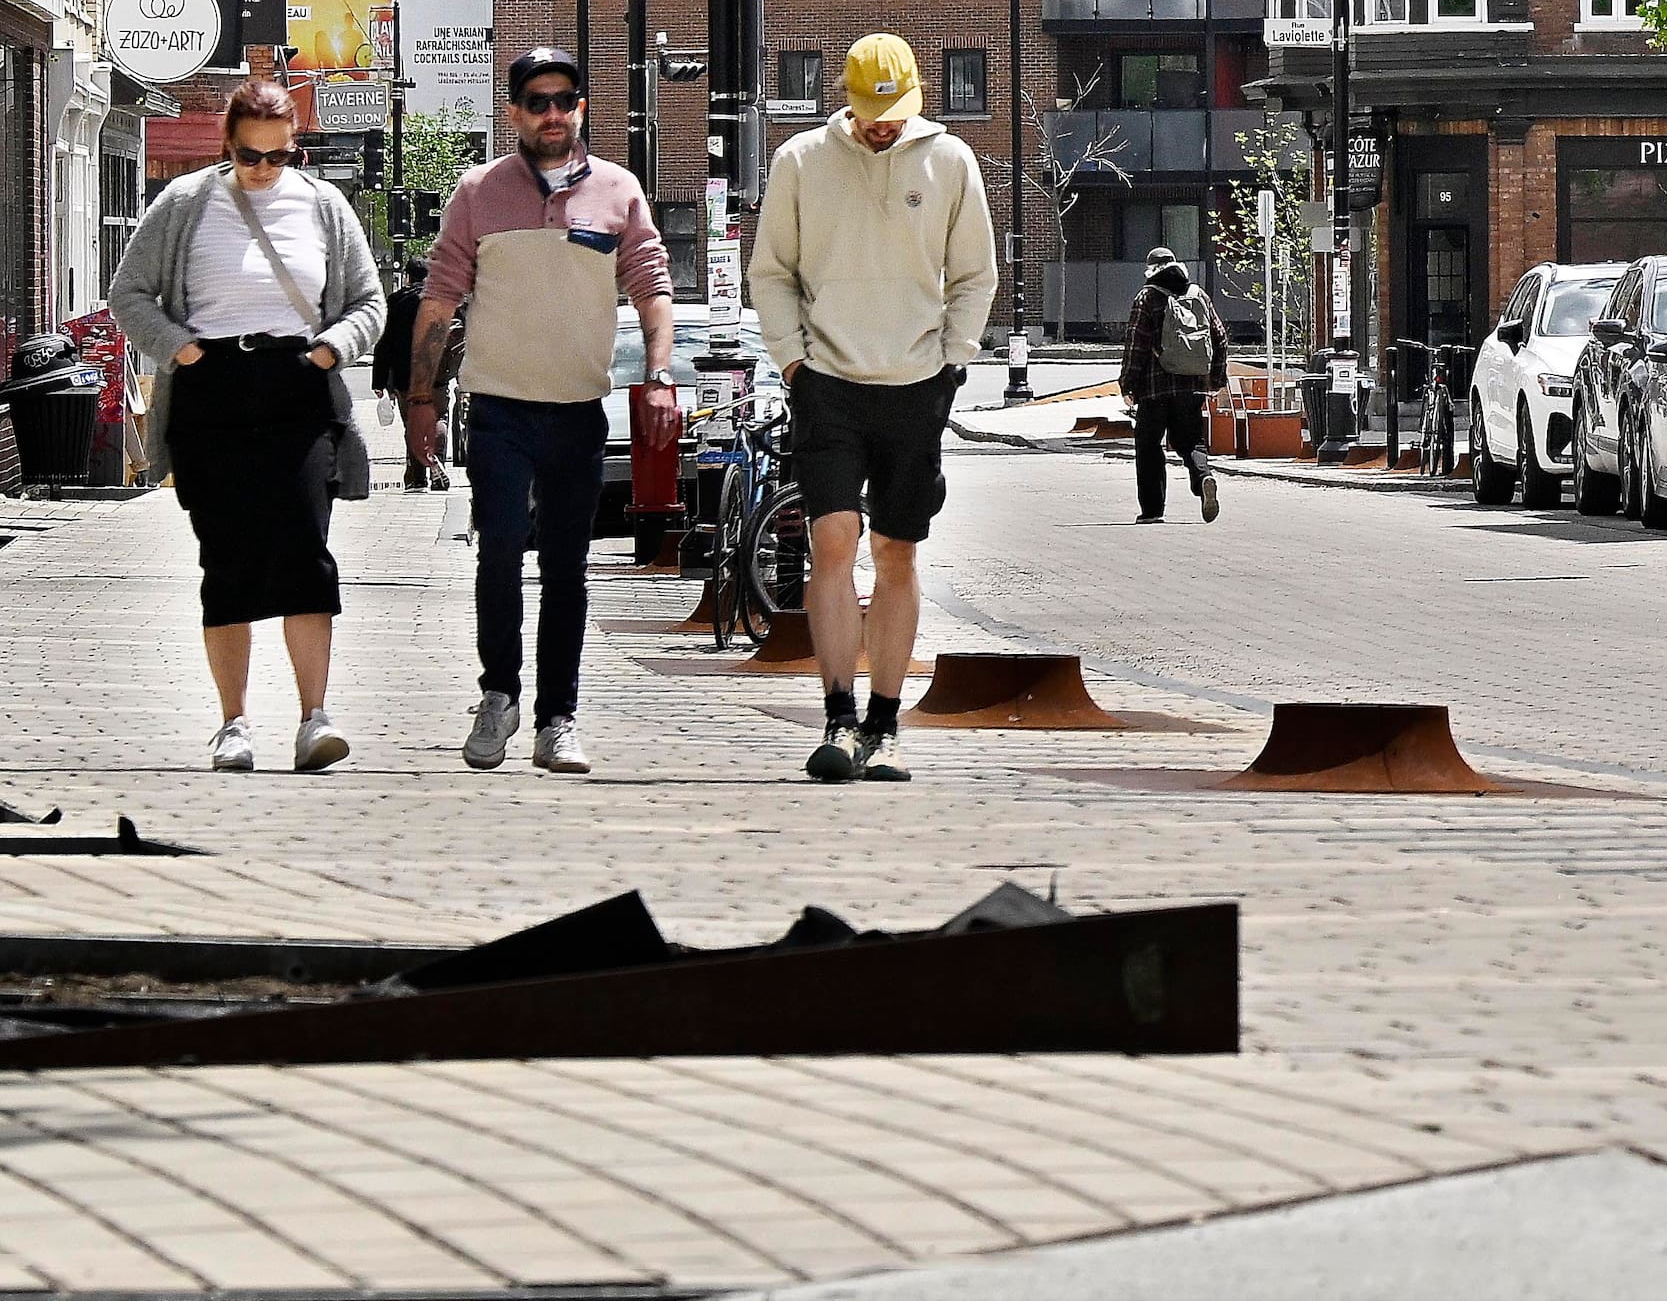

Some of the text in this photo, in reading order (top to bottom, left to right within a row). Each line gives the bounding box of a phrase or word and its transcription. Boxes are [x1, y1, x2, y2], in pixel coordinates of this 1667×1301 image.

[434, 27, 451, 38] UNE
[1272, 29, 1325, 42] Laviolette
[119, 30, 206, 52] ZOZO+ARTY
[414, 53, 460, 64] COCKTAILS
[320, 91, 385, 107] TAVERNE
[324, 112, 382, 125] JOS. DION
[1348, 134, 1377, 153] CÔTE
[1439, 191, 1452, 203] 95
